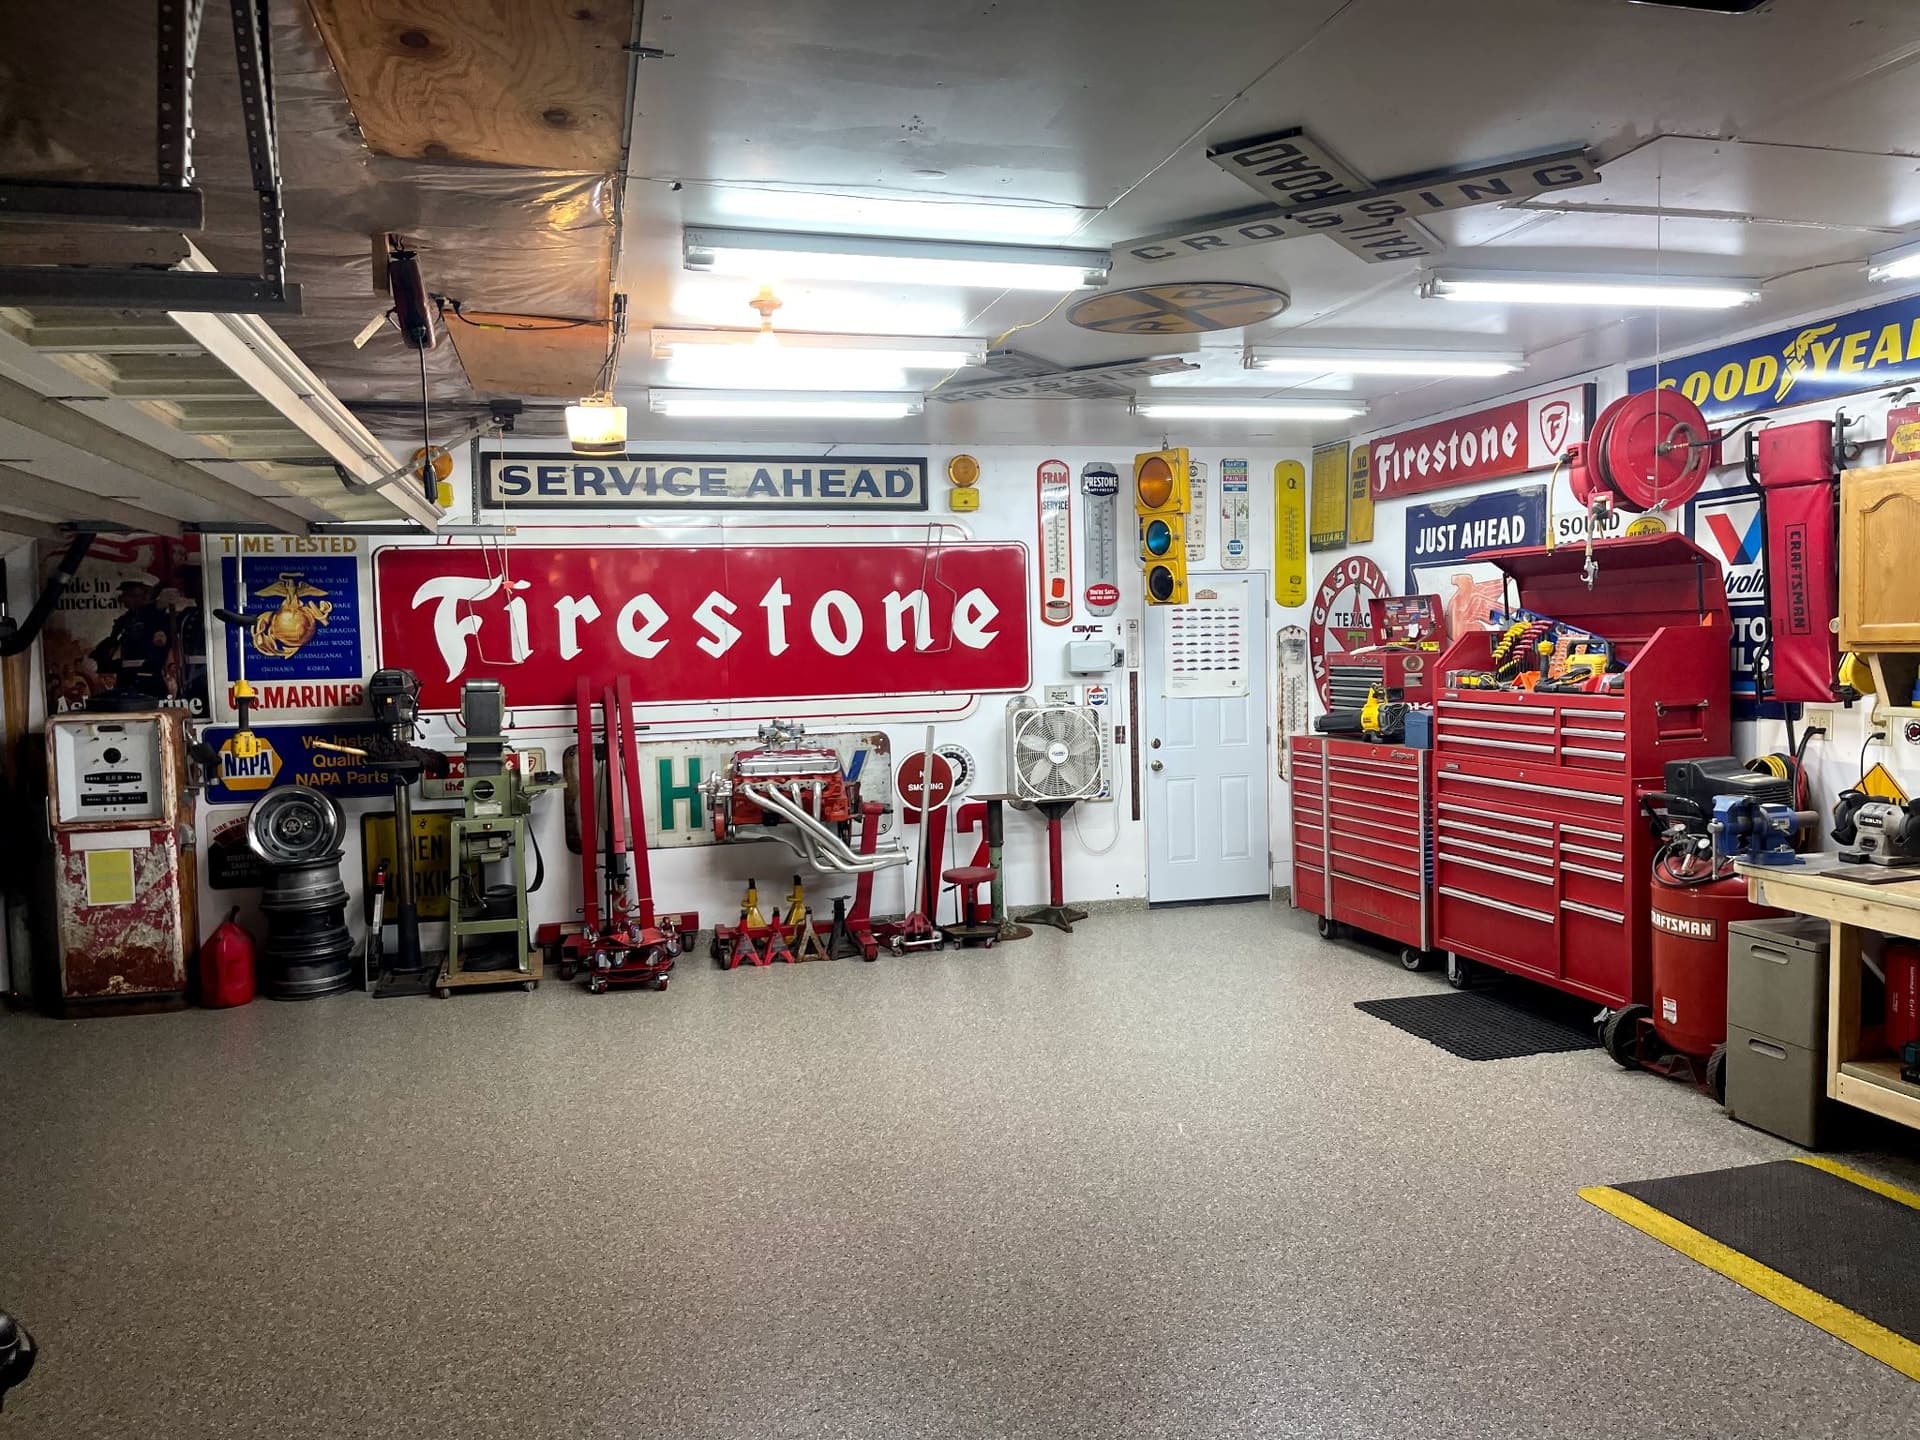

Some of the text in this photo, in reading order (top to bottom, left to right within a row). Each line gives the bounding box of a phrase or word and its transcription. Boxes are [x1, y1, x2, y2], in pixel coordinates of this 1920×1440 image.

[1232, 143, 1353, 203] ROAD
[1130, 165, 1584, 260] CROSSING
[1374, 421, 1518, 493] Firestone
[498, 465, 914, 498] SERVICE AHEAD
[1042, 472, 1067, 483] FRAM
[1084, 476, 1118, 487] PRESTONE
[221, 536, 357, 553] TME TESTED
[1415, 515, 1525, 555] JUST AHEAD
[1790, 530, 1805, 629] CRAFTSMAN
[55, 595, 118, 610] merica
[1313, 560, 1391, 625] GASOLIN
[411, 575, 1000, 683] Firestone
[1072, 625, 1103, 633] GMC
[1335, 612, 1371, 627] TEXAC
[224, 752, 271, 777] NAPA
[312, 753, 363, 768] Qualit
[295, 771, 388, 786] NAPA Parts
[907, 782, 944, 791] SMOING
[414, 835, 442, 860] EN
[1651, 909, 1712, 937] RAFTSMAN
